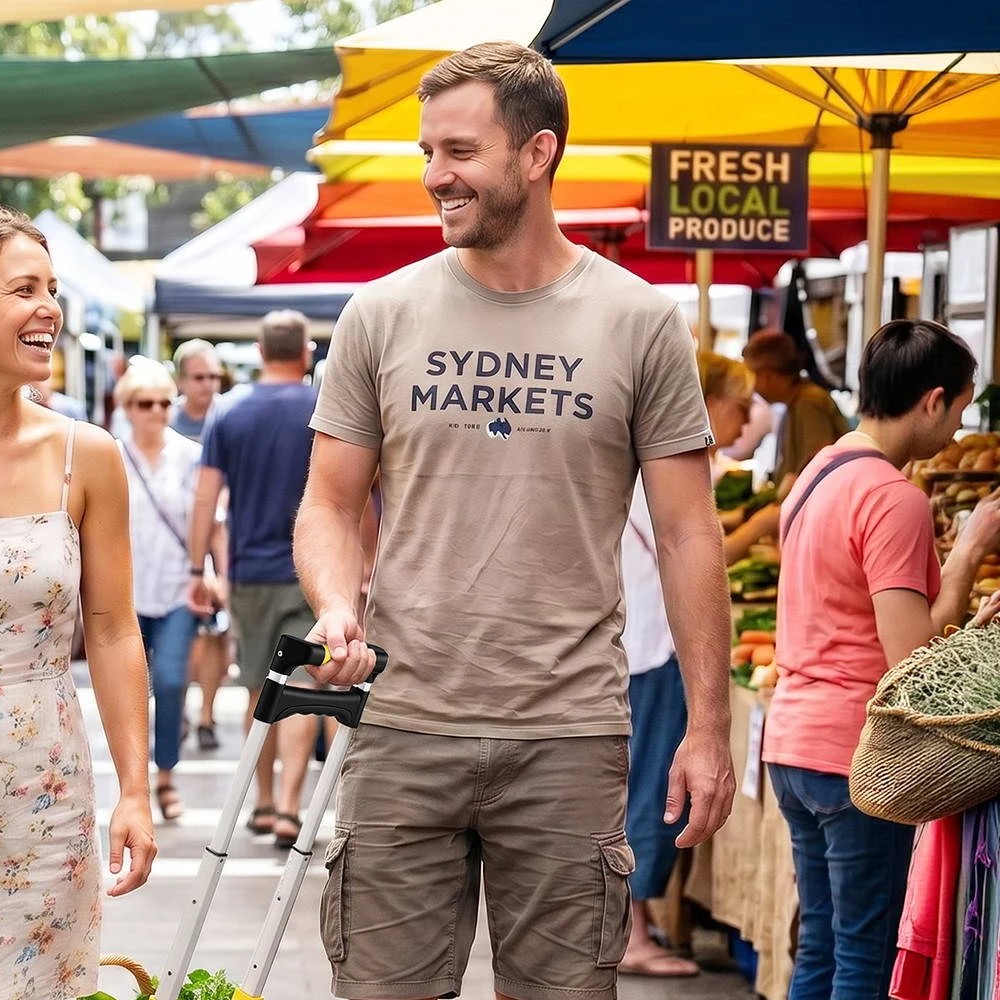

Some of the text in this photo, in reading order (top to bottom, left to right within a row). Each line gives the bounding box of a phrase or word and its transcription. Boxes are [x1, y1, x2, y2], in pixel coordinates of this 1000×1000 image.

[670, 150, 790, 184] FRESH
[669, 184, 790, 217] LOCAL
[668, 217, 790, 242] PRODUCE
[426, 350, 583, 383] SYDNEY
[410, 383, 594, 421] MARKETS
